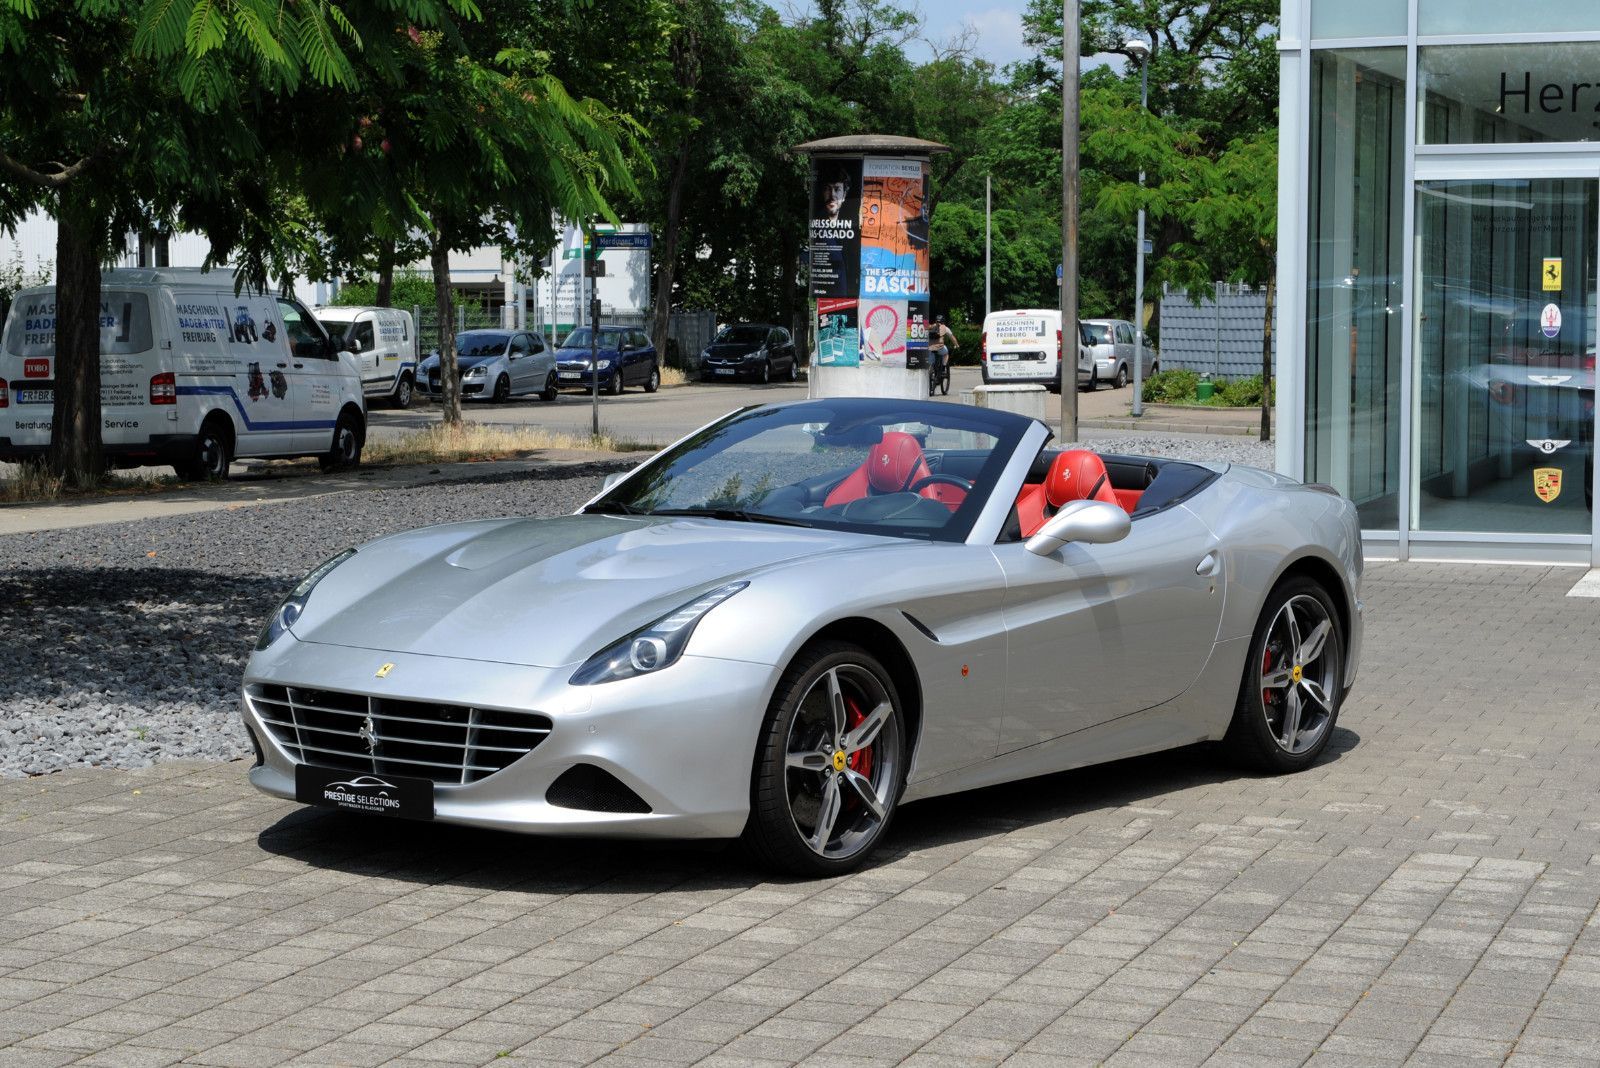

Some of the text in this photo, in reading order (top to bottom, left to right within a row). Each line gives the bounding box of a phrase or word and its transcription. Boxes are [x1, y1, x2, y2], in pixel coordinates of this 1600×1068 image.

[865, 268, 880, 276] THE
[176, 304, 220, 316] MASCHINEN
[178, 317, 226, 330] BADER-RITTER
[182, 331, 217, 343] FREIBURG
[26, 364, 48, 372] TORO
[15, 421, 52, 431] Beratung
[104, 420, 139, 429] Service
[324, 790, 400, 809] PRESTIGE SELECTIONS
